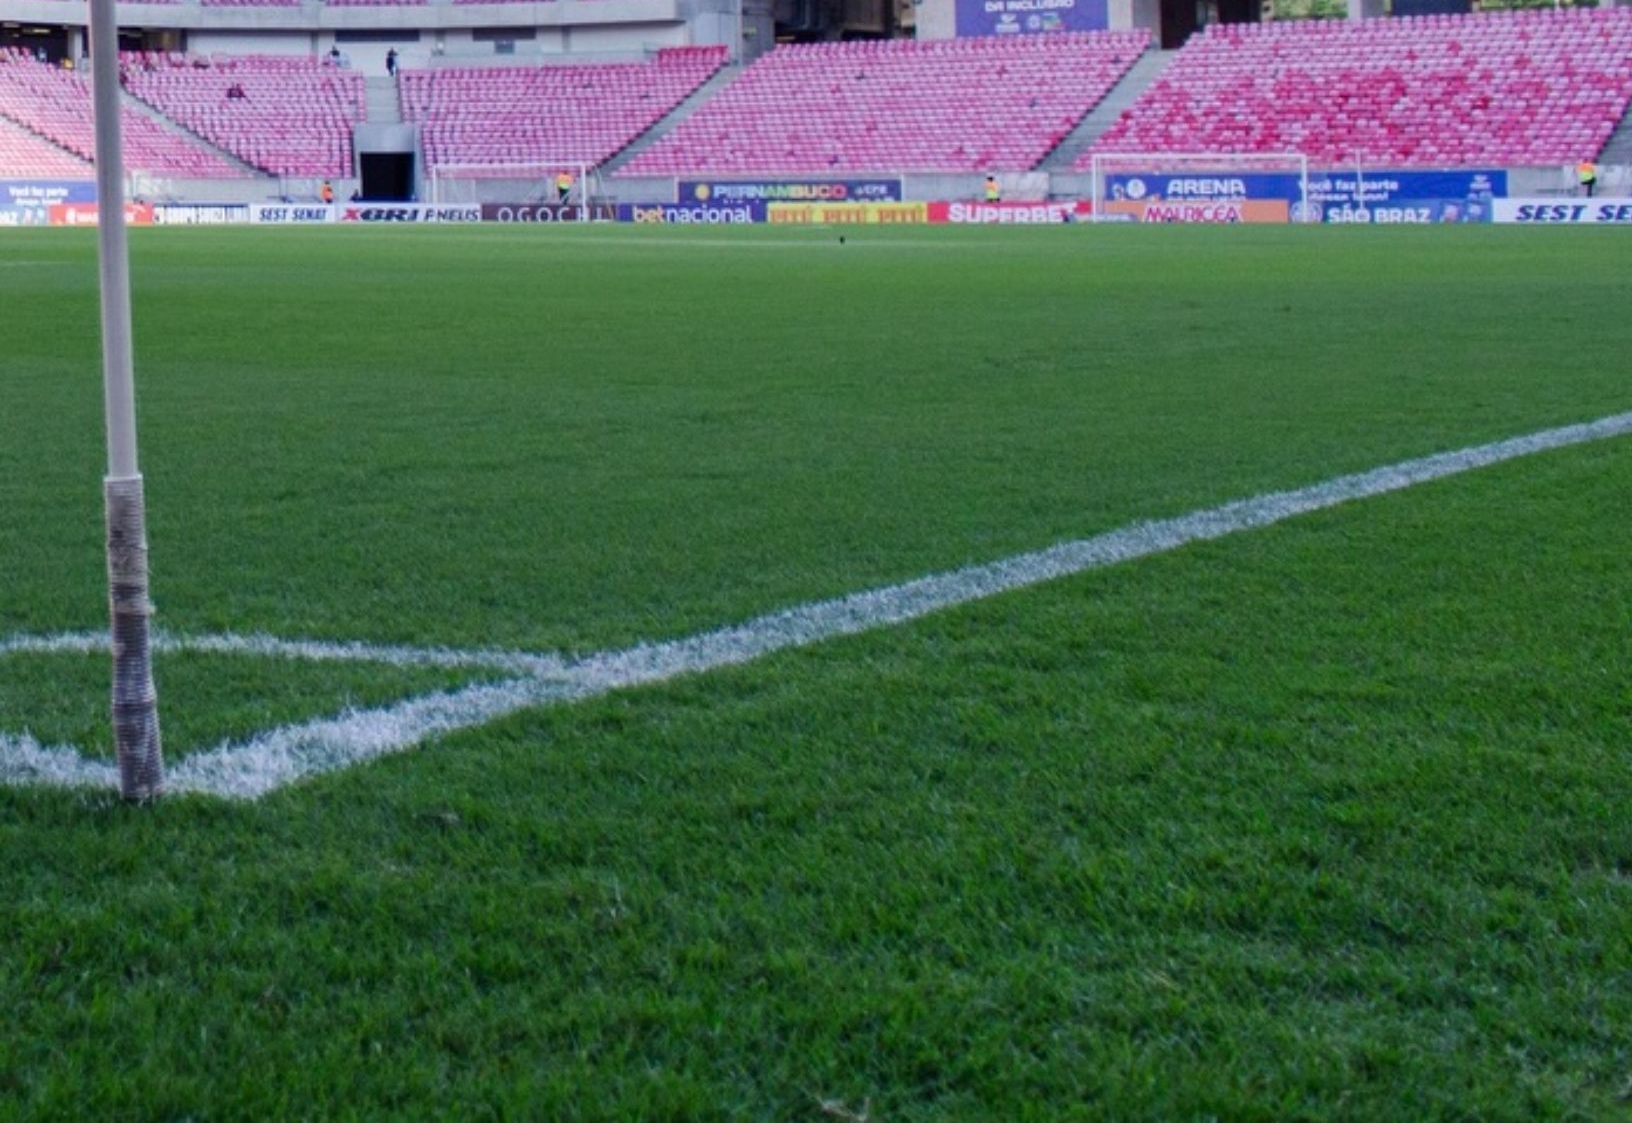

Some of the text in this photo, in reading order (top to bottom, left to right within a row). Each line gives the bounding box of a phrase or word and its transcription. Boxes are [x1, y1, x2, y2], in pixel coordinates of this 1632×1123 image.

[985, 0, 1004, 12] DA
[713, 184, 847, 198] PERNAMBUCO
[1167, 179, 1246, 194] ARENA
[424, 208, 479, 221] PNEUS
[633, 204, 752, 222] betnacional
[949, 201, 1078, 222] SUPERBET
[1374, 208, 1431, 223] BRAZ
[1516, 205, 1588, 220] SEST
